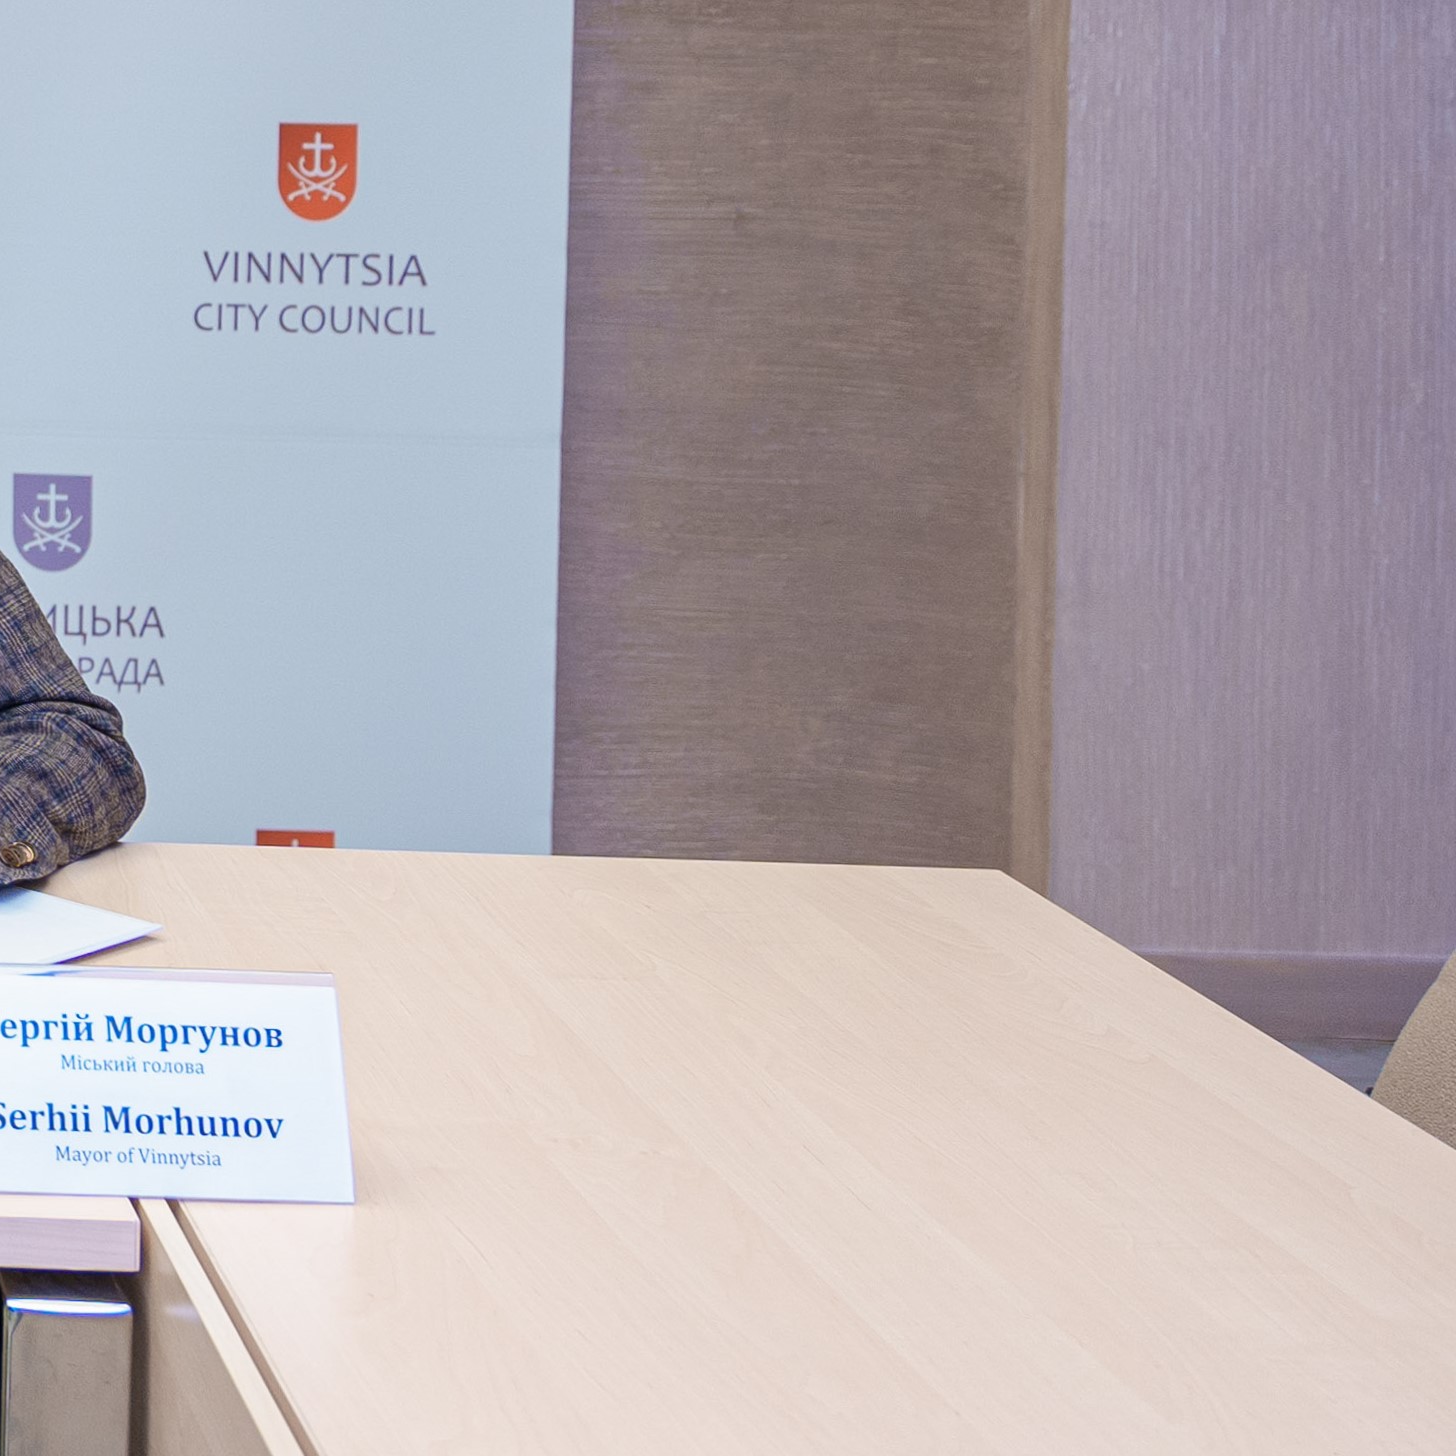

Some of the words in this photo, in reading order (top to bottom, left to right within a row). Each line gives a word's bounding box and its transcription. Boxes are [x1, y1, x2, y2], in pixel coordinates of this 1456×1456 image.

[203, 250, 428, 287] VINNYTSIA
[193, 302, 269, 332] CITY
[278, 304, 436, 336] COUNCIL
[78, 656, 165, 693] РАДА
[104, 1014, 284, 1054] Моргунов
[60, 1053, 138, 1073] Міський
[142, 1060, 206, 1075] голова
[102, 1104, 285, 1140] Morhunov
[55, 1145, 113, 1167] Mayor
[117, 1146, 137, 1163] of
[138, 1147, 223, 1170] Vinnytsia
